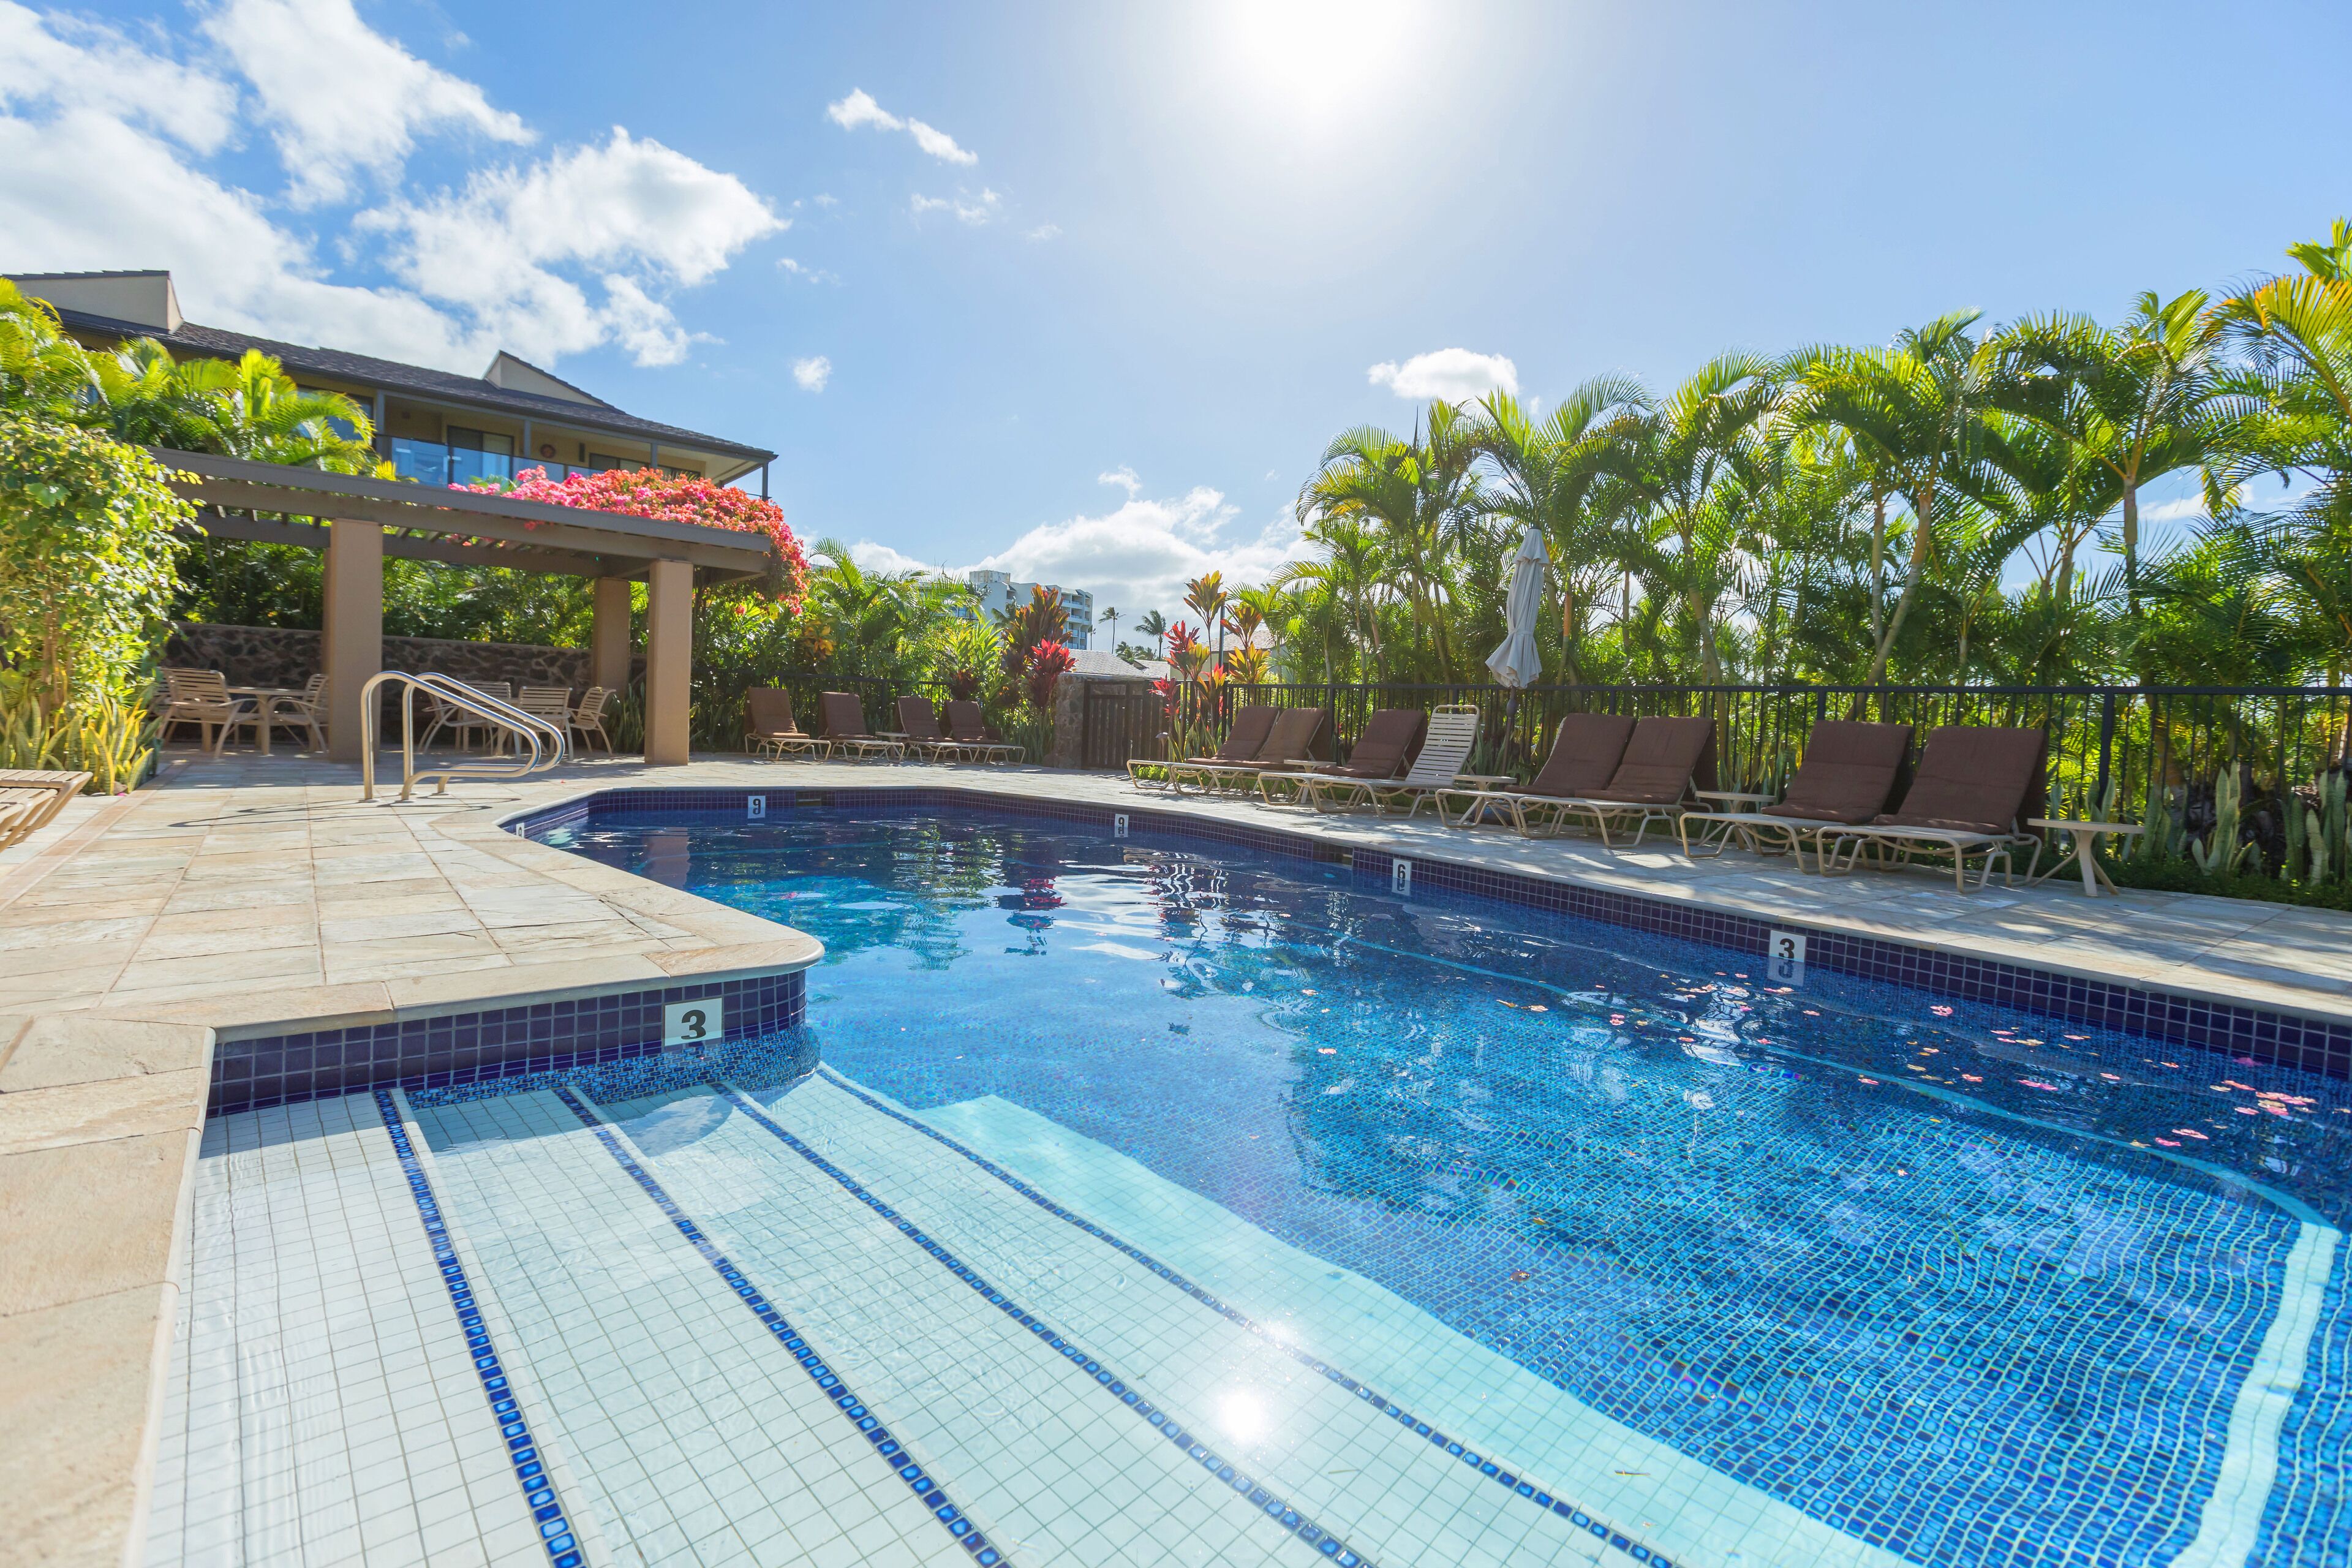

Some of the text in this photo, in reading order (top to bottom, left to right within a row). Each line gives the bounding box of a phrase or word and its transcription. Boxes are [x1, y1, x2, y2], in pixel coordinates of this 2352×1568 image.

[753, 798, 761, 814] 9
[1118, 816, 1125, 834] 9
[1397, 864, 1406, 880] 6
[1779, 938, 1795, 960] 3
[681, 1009, 706, 1039] 3
